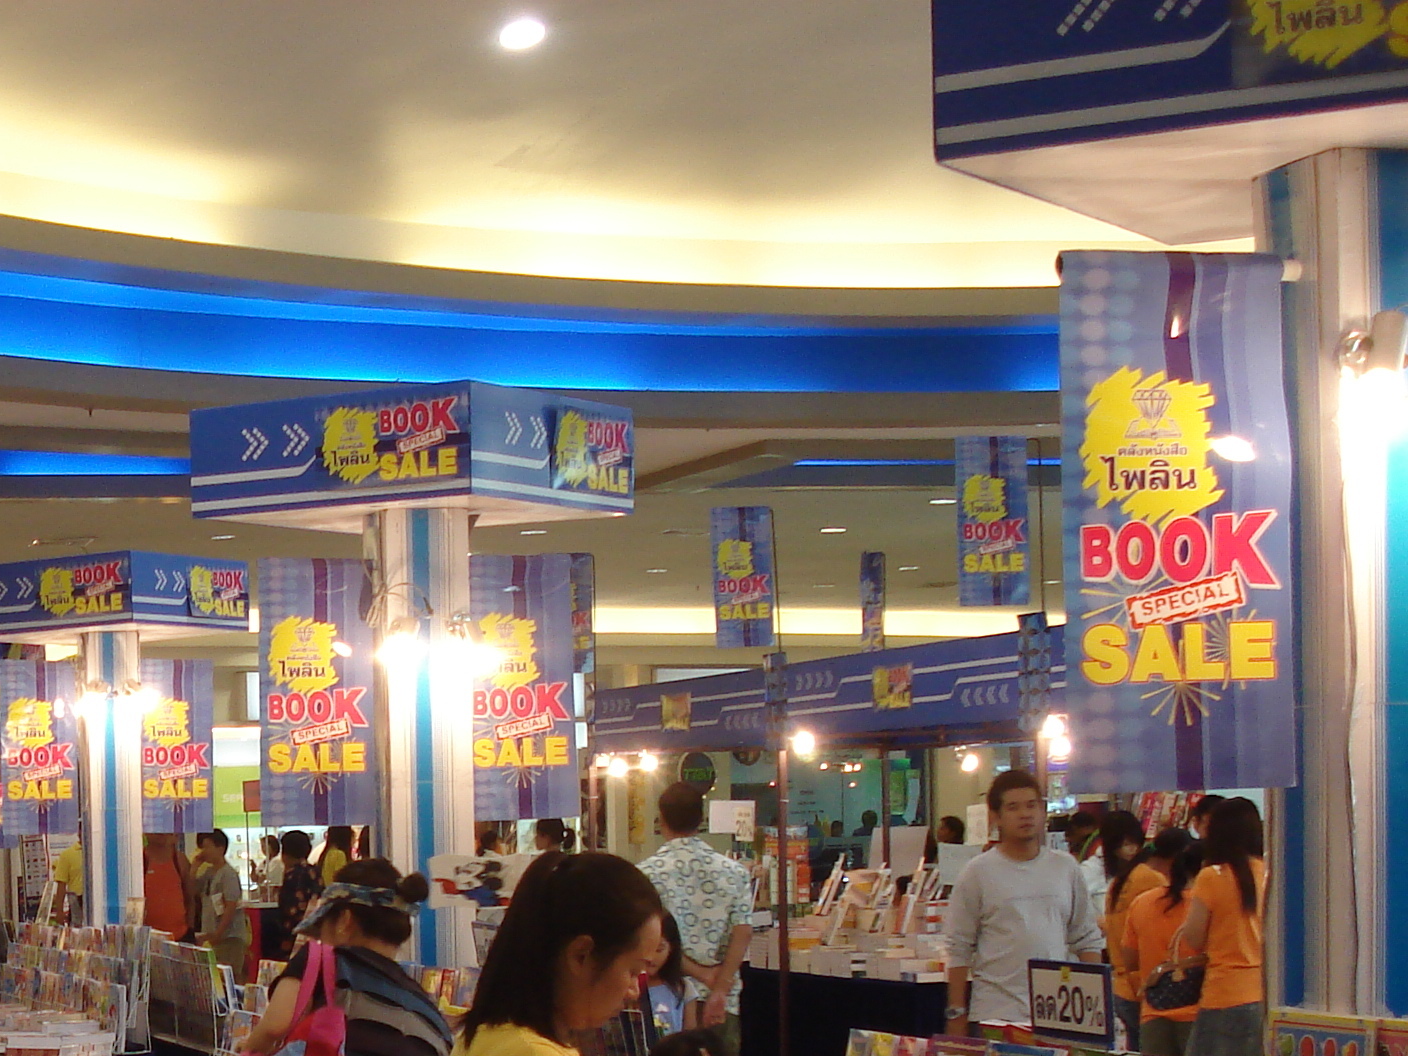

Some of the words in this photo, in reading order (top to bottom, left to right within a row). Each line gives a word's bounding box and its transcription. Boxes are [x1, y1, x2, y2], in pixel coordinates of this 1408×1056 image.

[378, 396, 460, 436] BOOK
[401, 430, 442, 452] SPECIAL
[585, 420, 630, 456] BOOK
[331, 448, 371, 469] ไพลิน
[379, 446, 459, 481] SALE
[586, 465, 630, 494] SALE
[1100, 455, 1197, 492] ไพลิน
[963, 518, 1026, 544] BOOK
[1080, 509, 1282, 590] BOOK
[74, 562, 123, 585] BOOK
[963, 552, 1024, 574] SALE
[212, 570, 243, 591] BOOK
[717, 574, 770, 596] BOOK
[75, 593, 123, 614] SALE
[215, 600, 245, 617] SALE
[719, 603, 770, 620] SALE
[1141, 583, 1229, 617] SPECIAL
[1082, 621, 1277, 685] SALE
[279, 660, 326, 679] ไพลิน
[268, 687, 369, 727] BOOK
[473, 682, 571, 722] BOOK
[297, 723, 343, 740] SPECIAL
[500, 714, 548, 735] SPECIAL
[7, 743, 75, 769] BOOK
[143, 743, 209, 769] BOOK
[268, 742, 366, 773] SALE
[473, 736, 569, 768] SALE
[8, 779, 72, 799] SALE
[143, 778, 208, 798] SALE
[1035, 985, 1104, 1027] ลด20%
